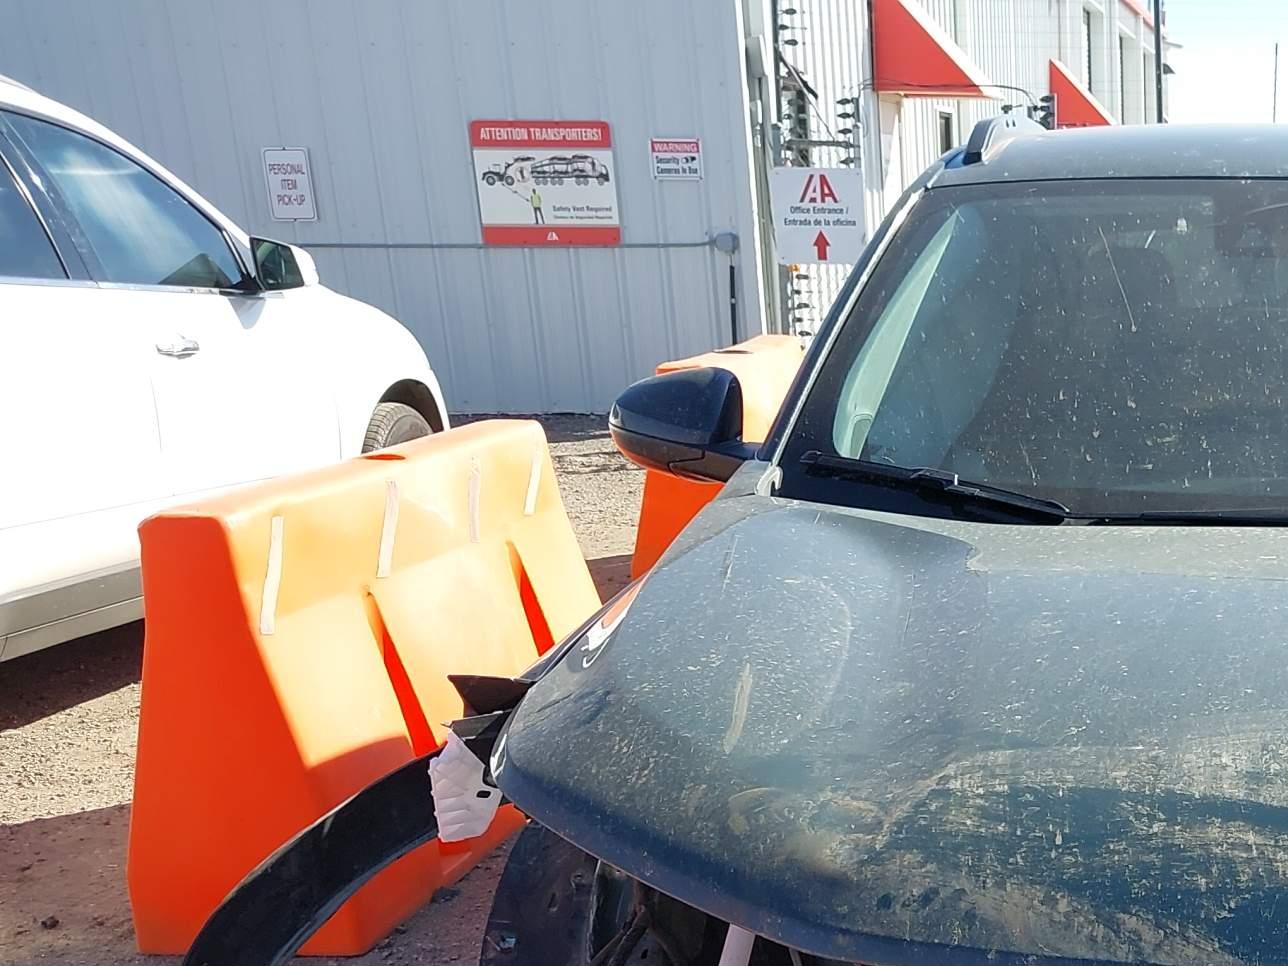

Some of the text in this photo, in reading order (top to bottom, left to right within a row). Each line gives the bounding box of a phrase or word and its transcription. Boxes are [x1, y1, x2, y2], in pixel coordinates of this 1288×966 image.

[480, 127, 602, 142] ATTENTION TRANSPORTERS!
[653, 143, 698, 152] WARNING
[268, 163, 306, 175] PERSONAL
[281, 178, 297, 190] ITEM
[277, 194, 306, 207] PICK-UP
[789, 206, 811, 215] Office
[812, 206, 844, 215] Entrance
[784, 218, 857, 227] Entrada de la oficina
